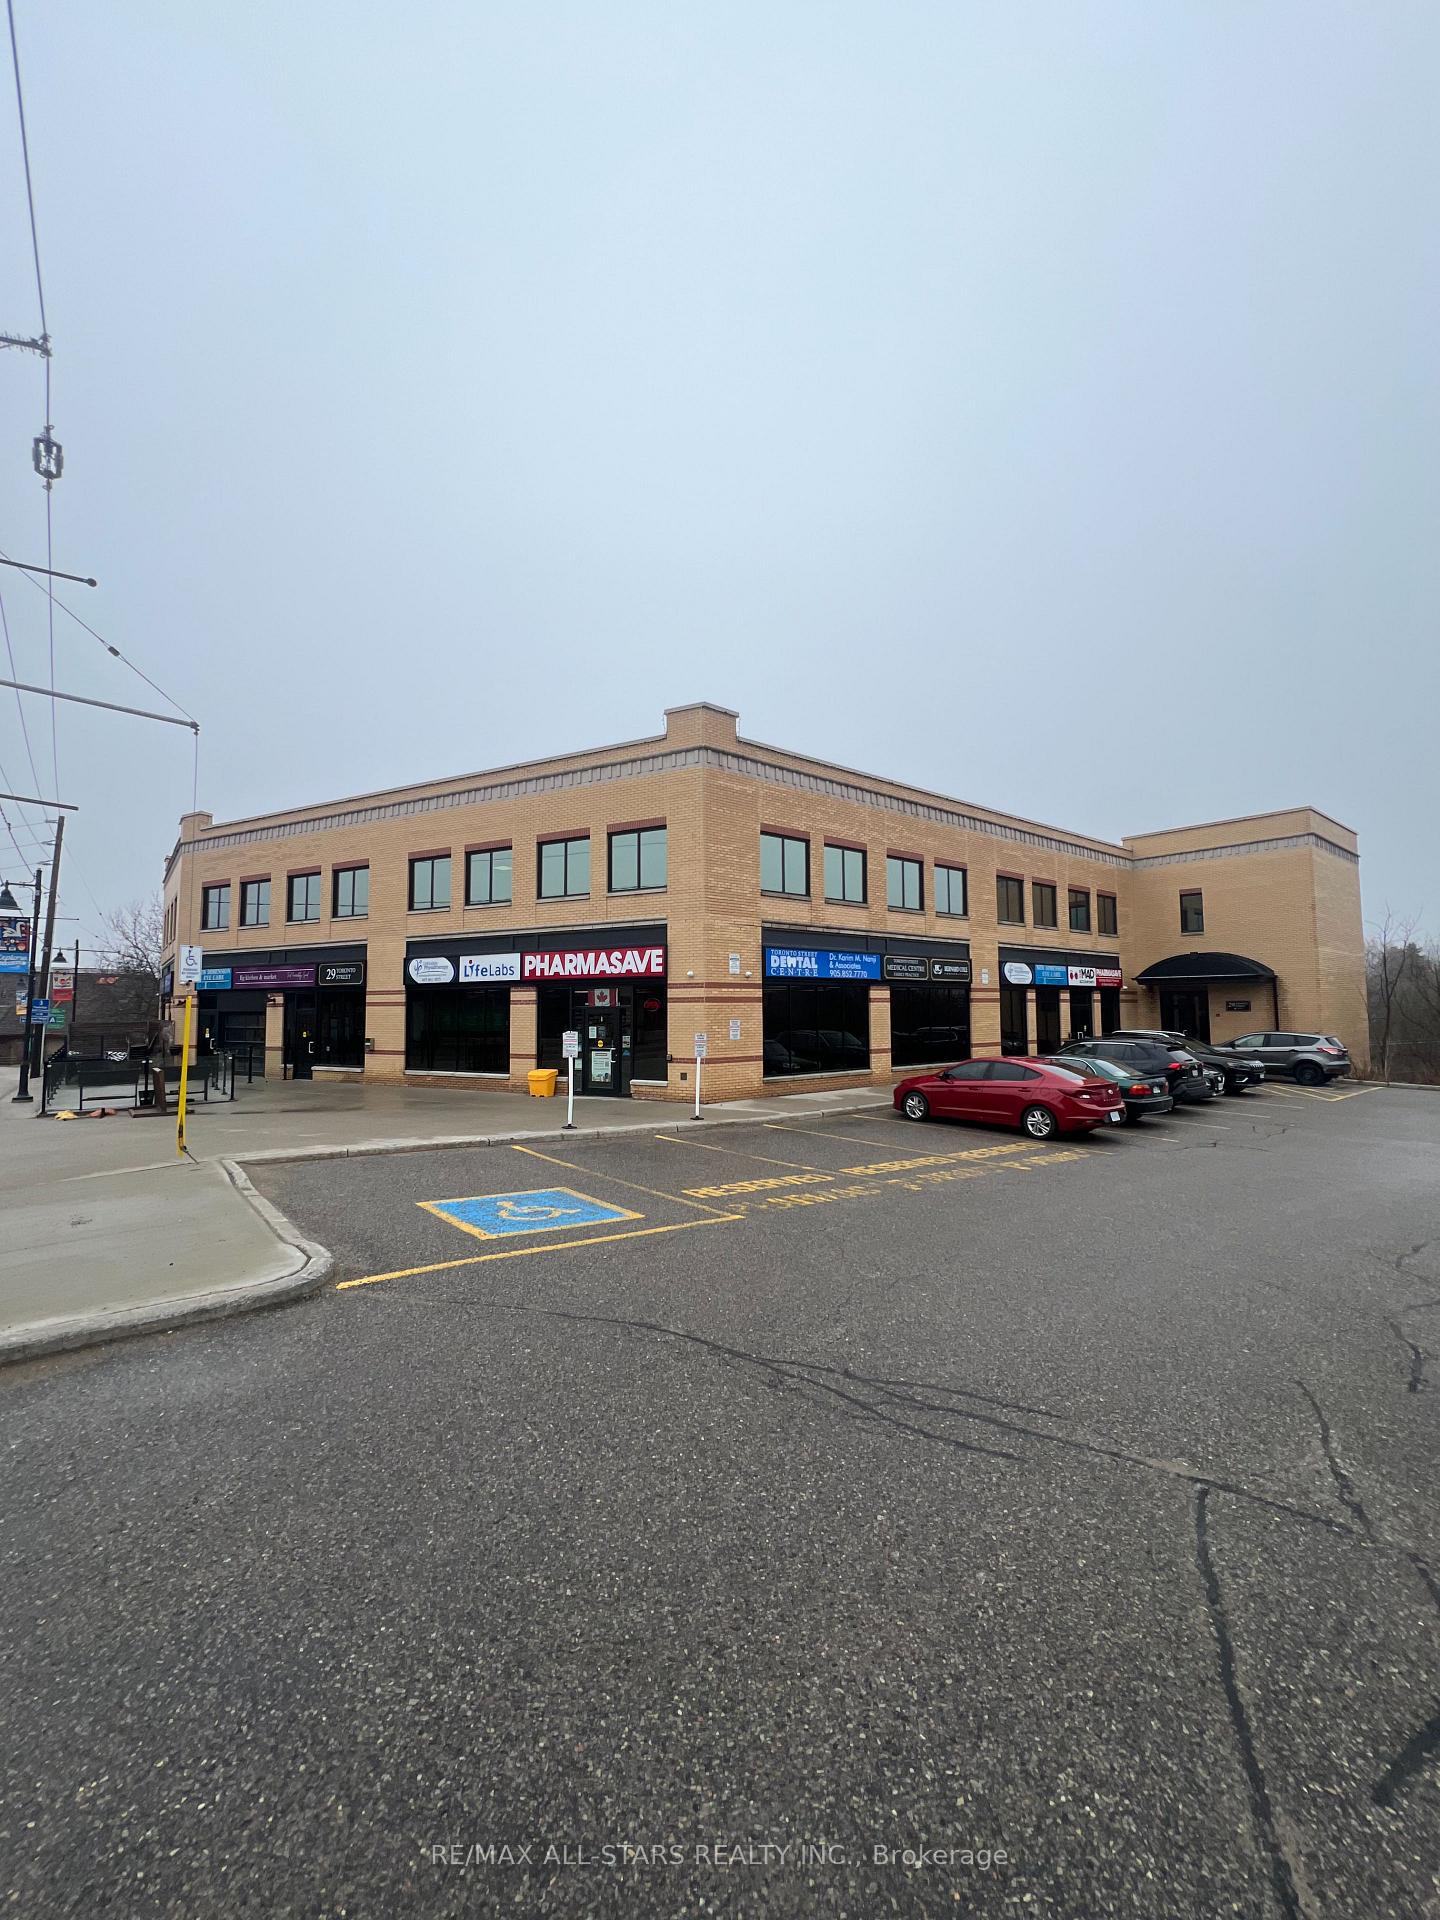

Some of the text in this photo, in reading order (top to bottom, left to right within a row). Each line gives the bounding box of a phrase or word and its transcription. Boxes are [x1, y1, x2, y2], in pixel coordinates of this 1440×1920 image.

[770, 949, 797, 957] TORONTO
[829, 952, 838, 961] Dr.
[854, 954, 862, 962] M.
[464, 959, 515, 977] LifeLabs
[524, 949, 663, 977] PHARMASAVE
[770, 955, 818, 969] DENTAL
[829, 960, 861, 970] & Associates
[326, 968, 336, 980] 29
[829, 969, 868, 978] 905.852.7770
[1081, 968, 1095, 980] MAD
[680, 1173, 835, 1198] RESERVED
